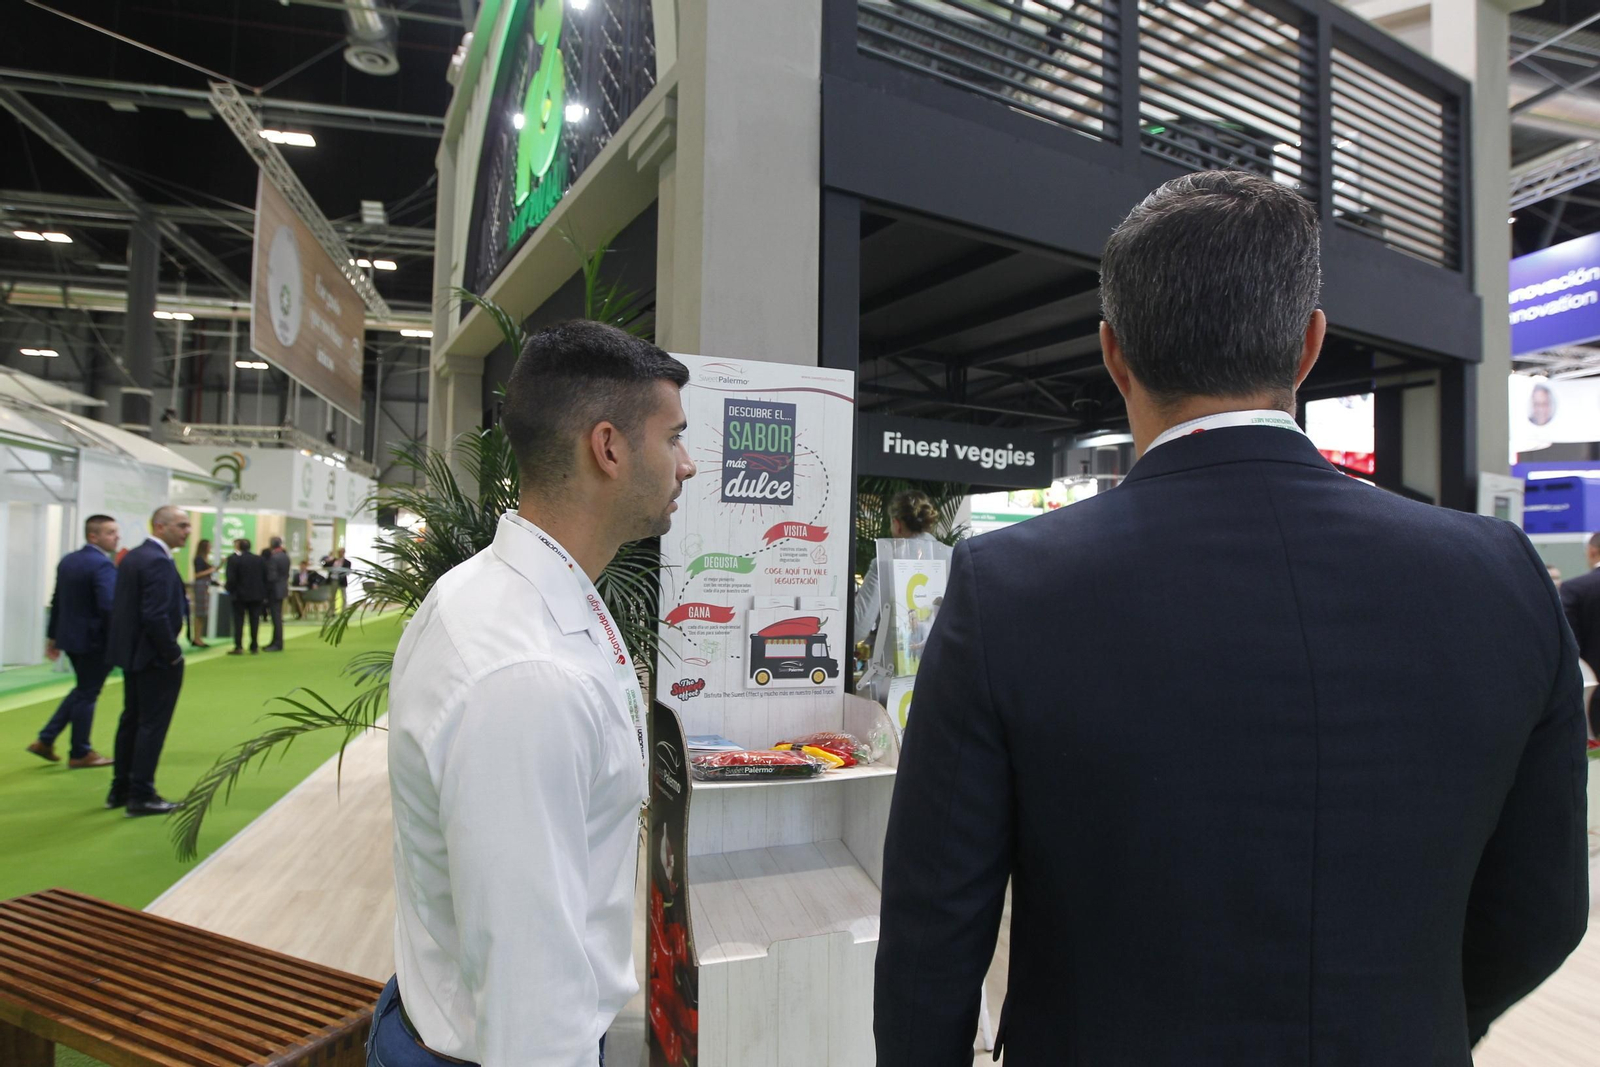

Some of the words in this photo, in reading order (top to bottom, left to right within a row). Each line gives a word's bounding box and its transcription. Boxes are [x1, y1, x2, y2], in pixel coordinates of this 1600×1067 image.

[1508, 290, 1598, 326] novation
[729, 405, 772, 419] DESCUBRE
[729, 421, 792, 453] SABOR
[883, 431, 949, 458] Finest
[954, 443, 1035, 470] veggies
[726, 458, 747, 469] más
[724, 471, 793, 500] dulce
[783, 525, 808, 537] VISITA
[704, 556, 739, 569] DEGUSTA
[764, 567, 783, 575] COGE
[587, 594, 600, 611] Agro
[688, 606, 710, 618] GANA
[597, 609, 622, 655] Santander
